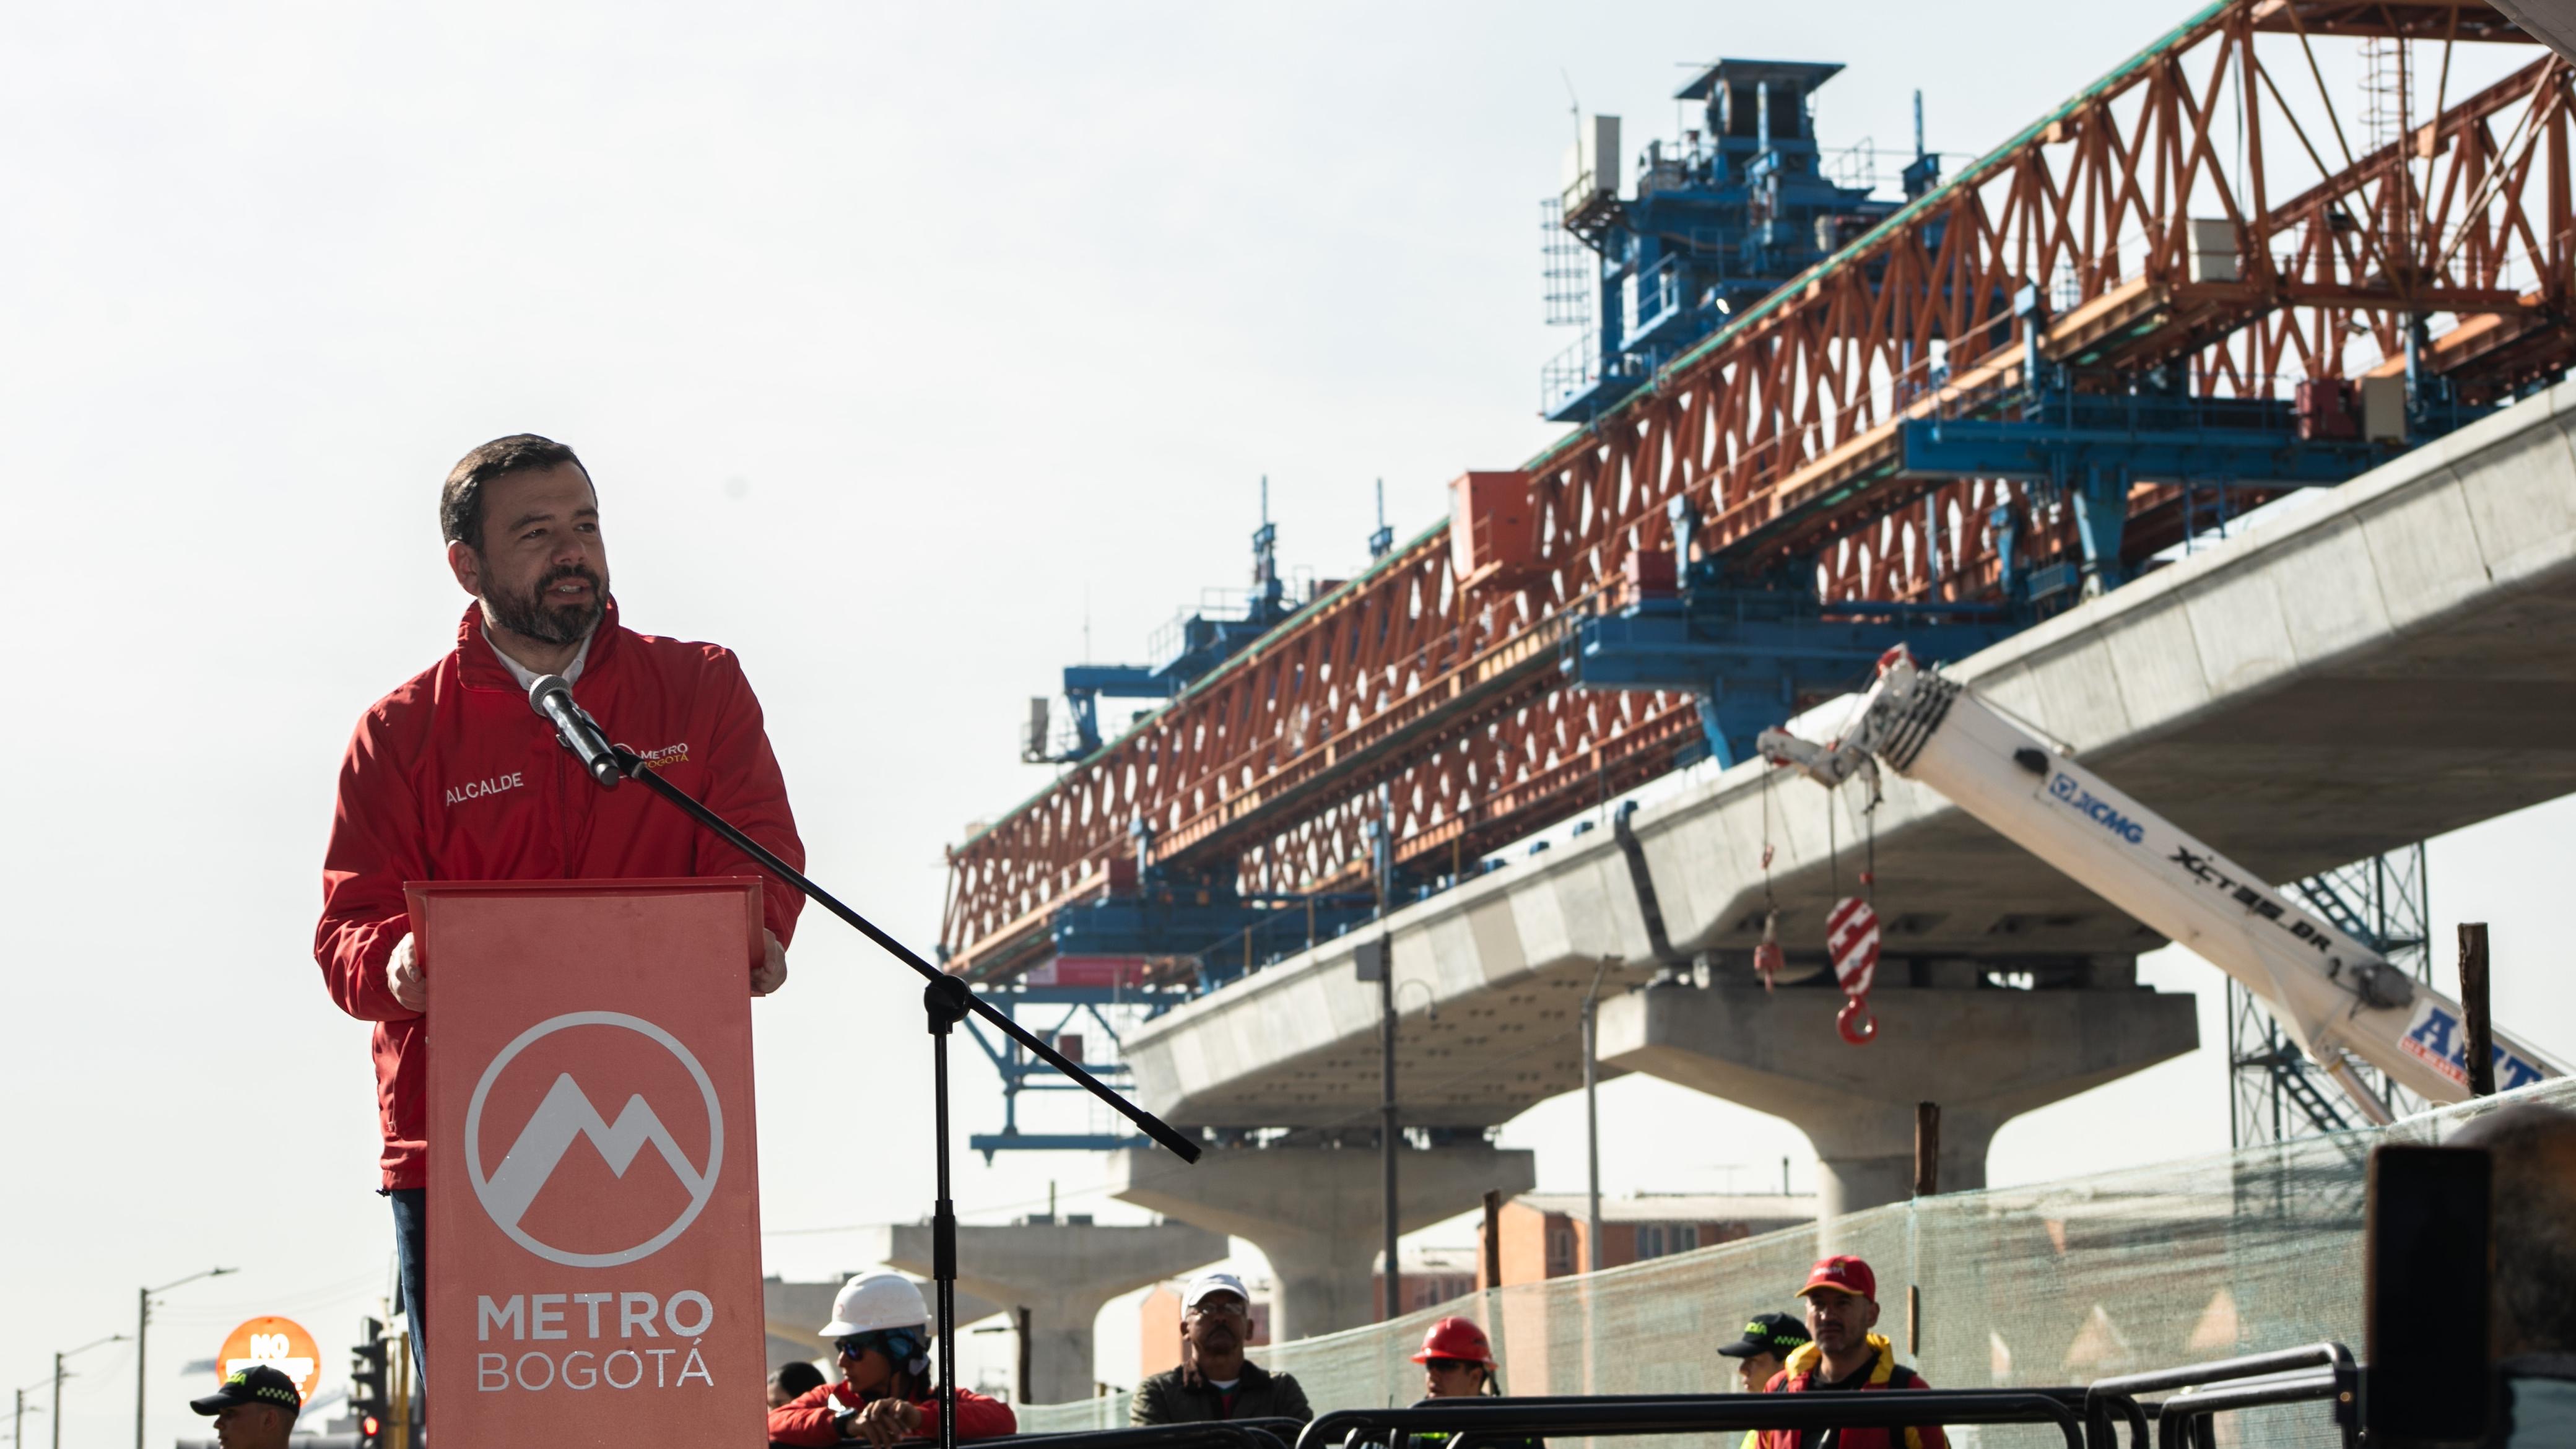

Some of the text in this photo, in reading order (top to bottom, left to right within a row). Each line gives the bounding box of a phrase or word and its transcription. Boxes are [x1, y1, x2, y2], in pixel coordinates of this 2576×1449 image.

[640, 743, 688, 760] METRO
[645, 752, 689, 768] OGOTÁ
[446, 772, 524, 807] ALCALDE
[2072, 791, 2144, 844] XCMG
[2411, 1006, 2543, 1092] AT
[477, 1290, 714, 1346] METRO
[250, 1333, 290, 1359] NO
[477, 1338, 714, 1393] BOGOTÁ
